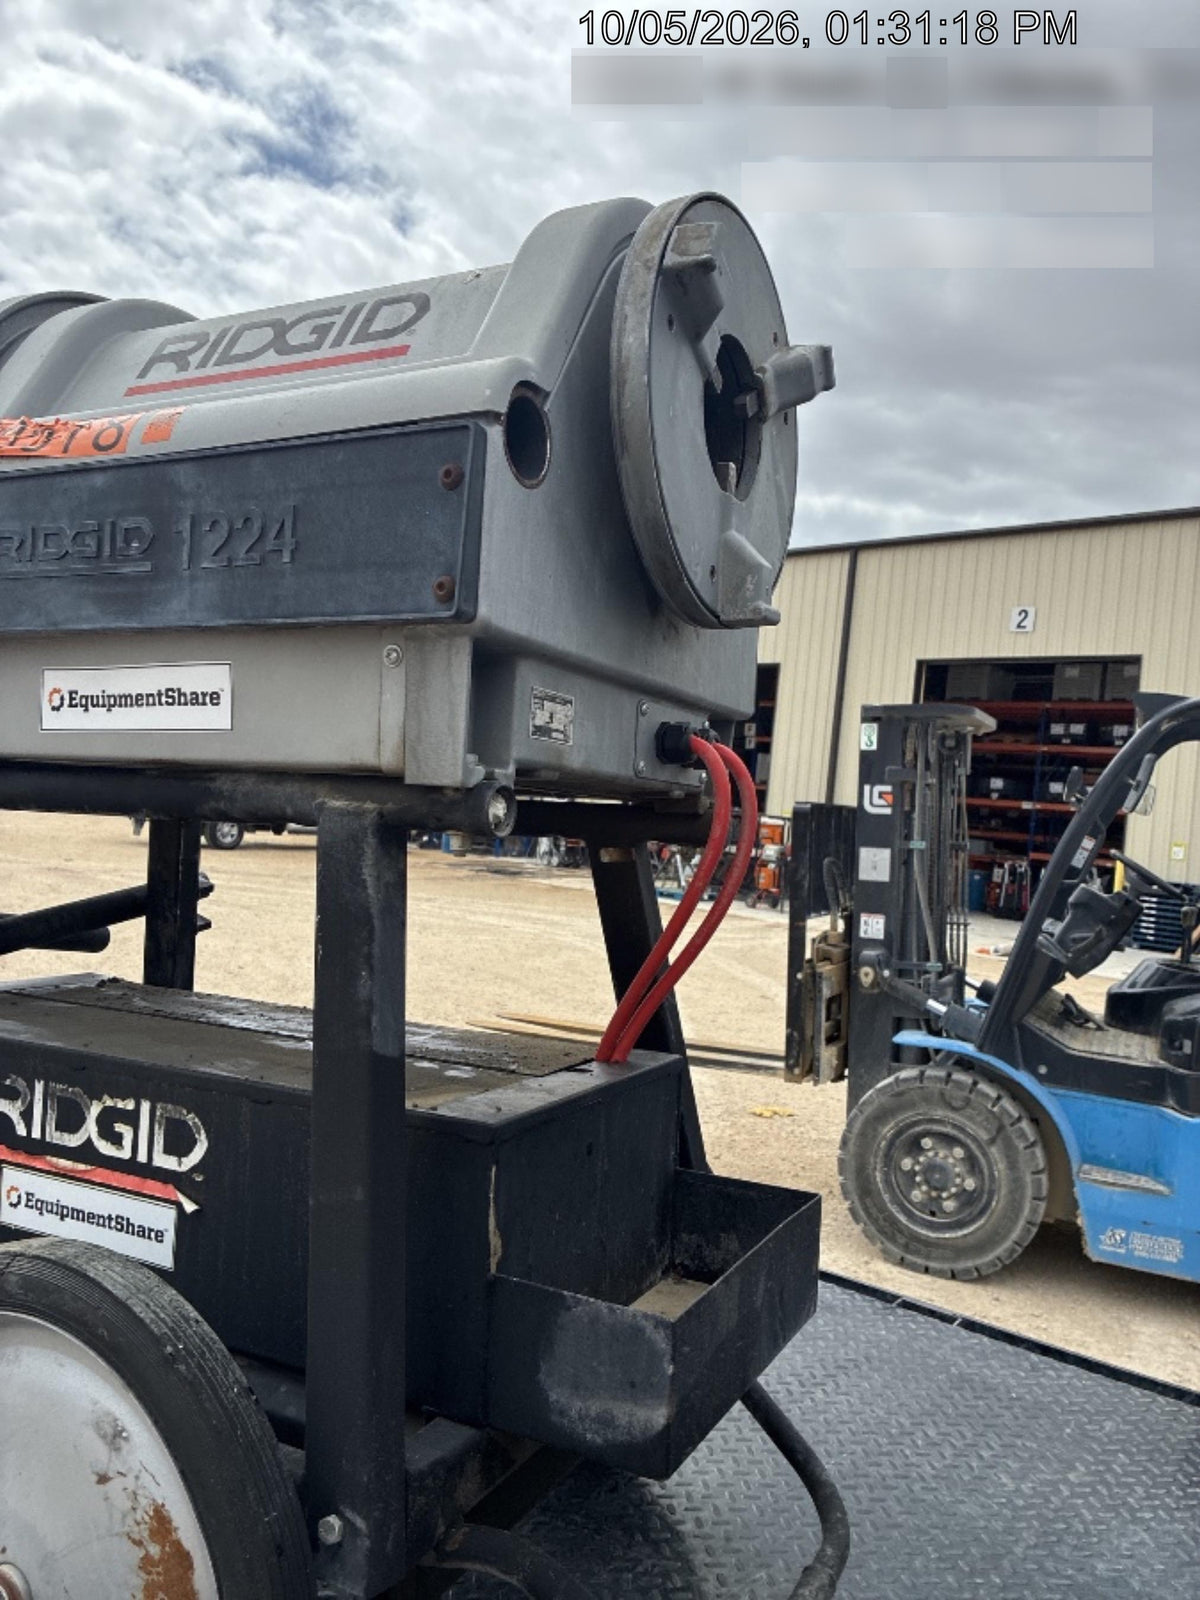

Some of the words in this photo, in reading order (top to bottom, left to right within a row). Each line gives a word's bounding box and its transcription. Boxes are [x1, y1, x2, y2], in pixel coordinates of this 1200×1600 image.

[135, 291, 431, 380] RIDGID
[174, 504, 299, 571] 1224
[1016, 608, 1029, 629] 2
[67, 687, 222, 713] EquipmentShare
[0, 1073, 209, 1173] RIDGID
[23, 1190, 166, 1244] EquipmentShare
